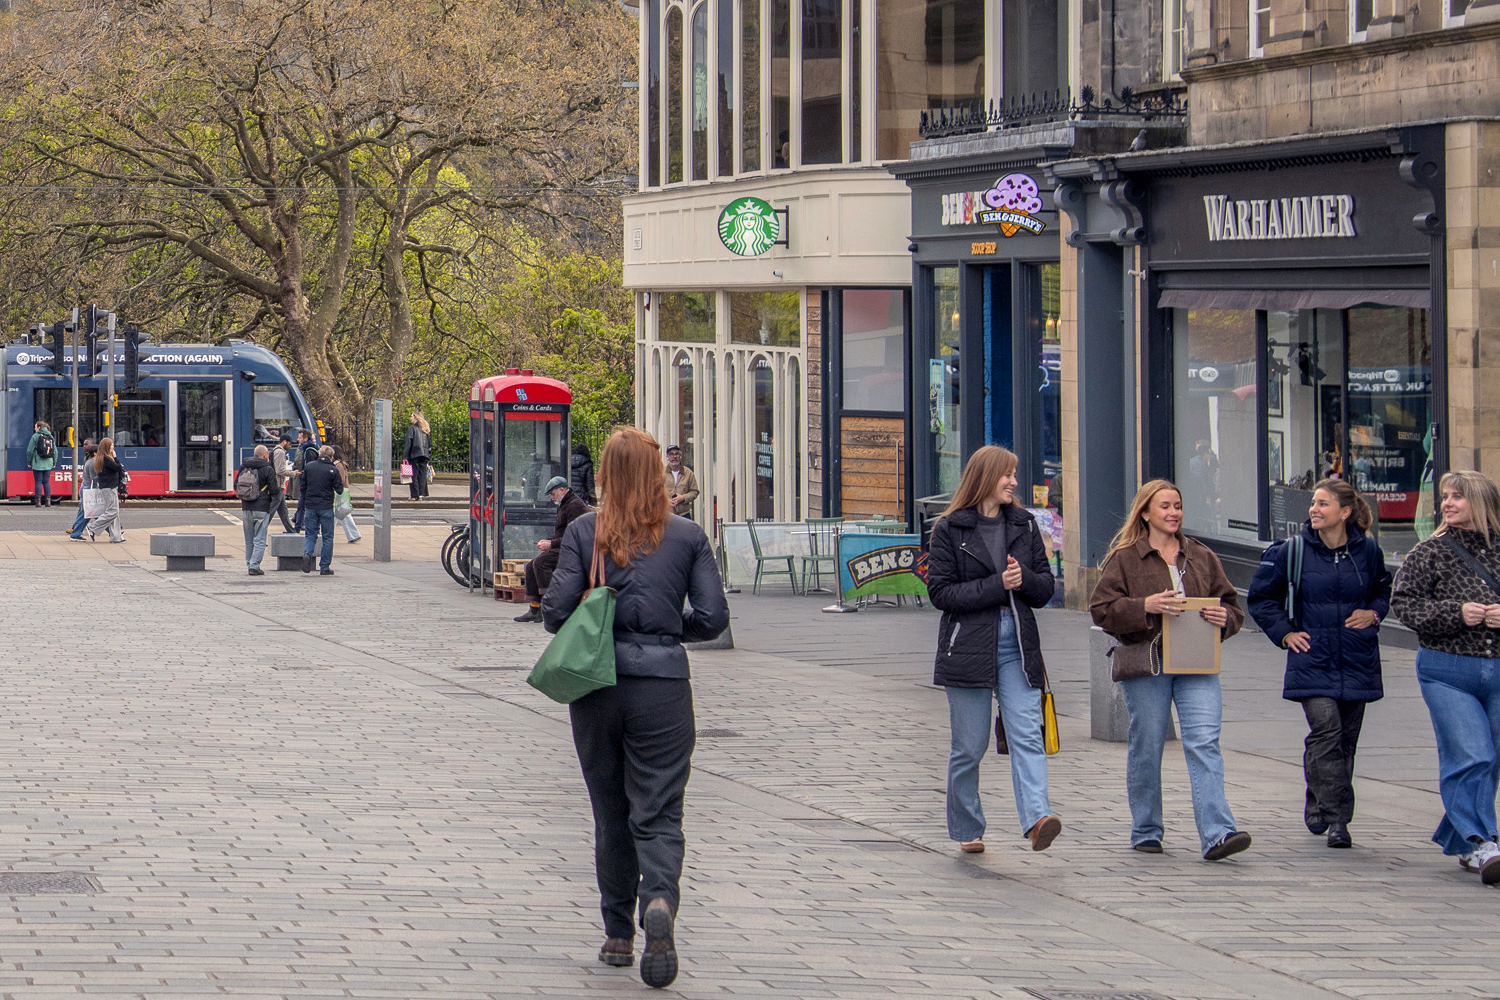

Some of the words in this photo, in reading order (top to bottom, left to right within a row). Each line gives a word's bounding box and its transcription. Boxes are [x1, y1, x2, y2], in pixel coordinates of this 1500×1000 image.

[982, 212, 1002, 223] BEN
[1009, 213, 1042, 232] JERRY'S
[184, 354, 223, 365] (AGAIN)
[855, 551, 897, 580] BEN
[898, 549, 914, 568] &
